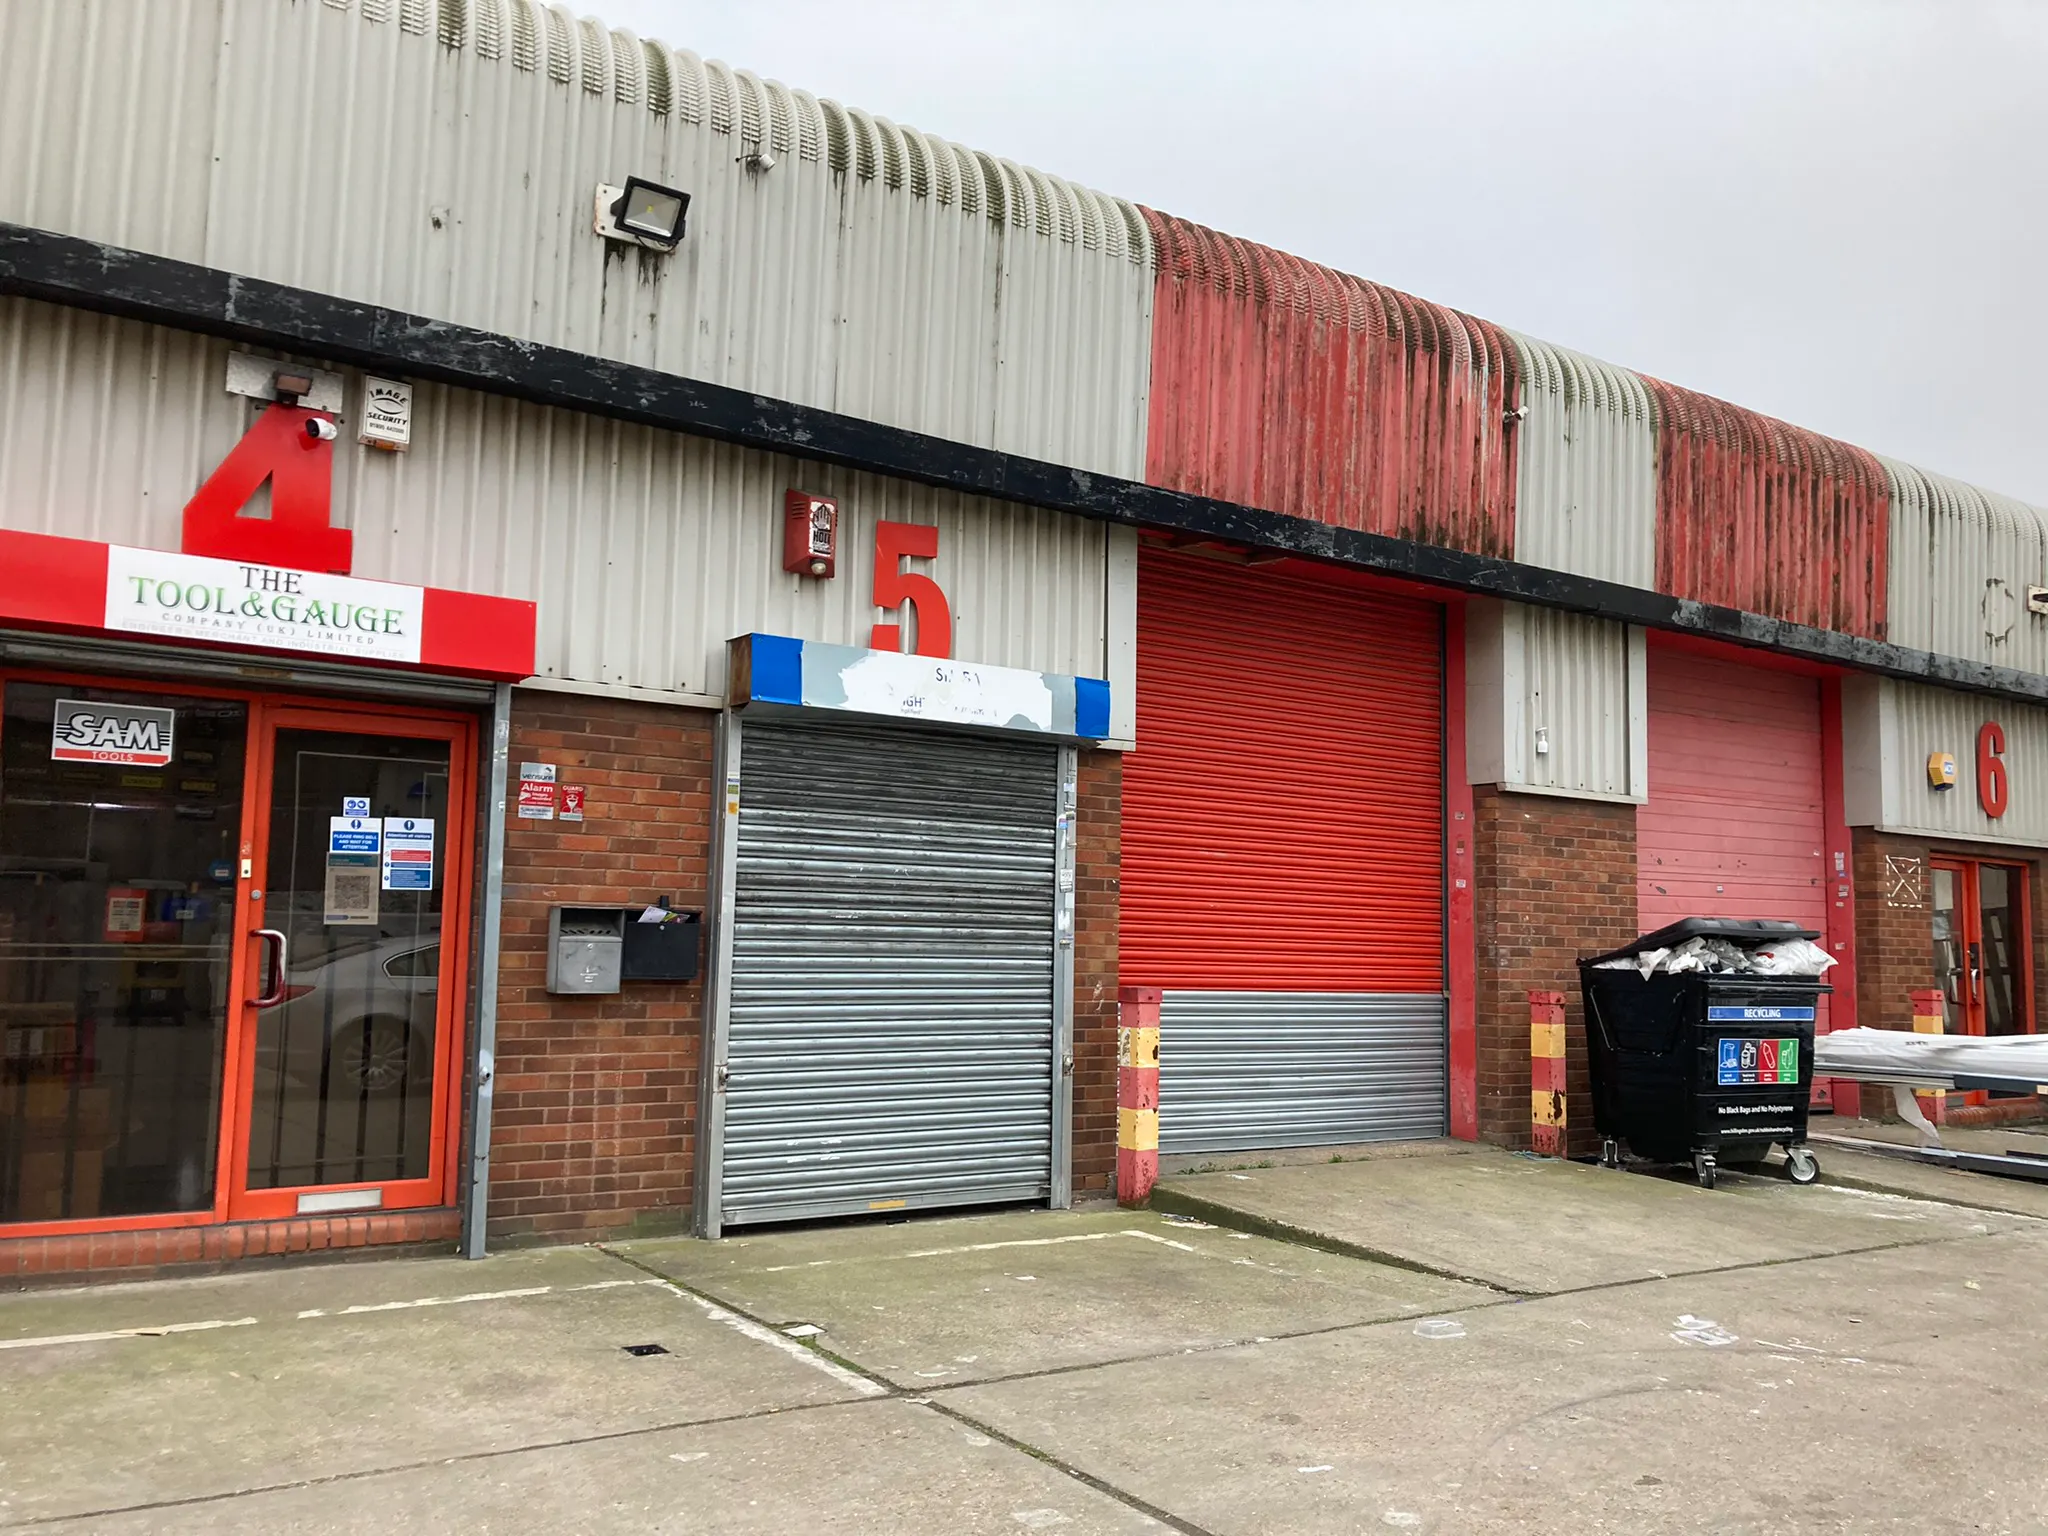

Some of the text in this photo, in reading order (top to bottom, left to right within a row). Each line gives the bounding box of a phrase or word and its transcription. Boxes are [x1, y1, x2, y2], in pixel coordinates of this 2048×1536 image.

[369, 388, 408, 404] IMAGE
[367, 412, 408, 425] SECURITY
[181, 402, 352, 576] 4
[239, 566, 303, 595] THE
[871, 519, 951, 660] 5
[162, 613, 375, 645] COMPANY (UK) LIMITED
[261, 637, 284, 647] AND
[287, 640, 351, 654] INDUSTRIAL
[63, 711, 161, 751] SAM
[92, 751, 134, 762] TOOLS
[1978, 720, 2008, 818] 6
[521, 783, 554, 792] Alarm
[1743, 1008, 1782, 1018] RECYCLING
[1718, 1104, 1794, 1115] No Black Bags and No Polystyrene
